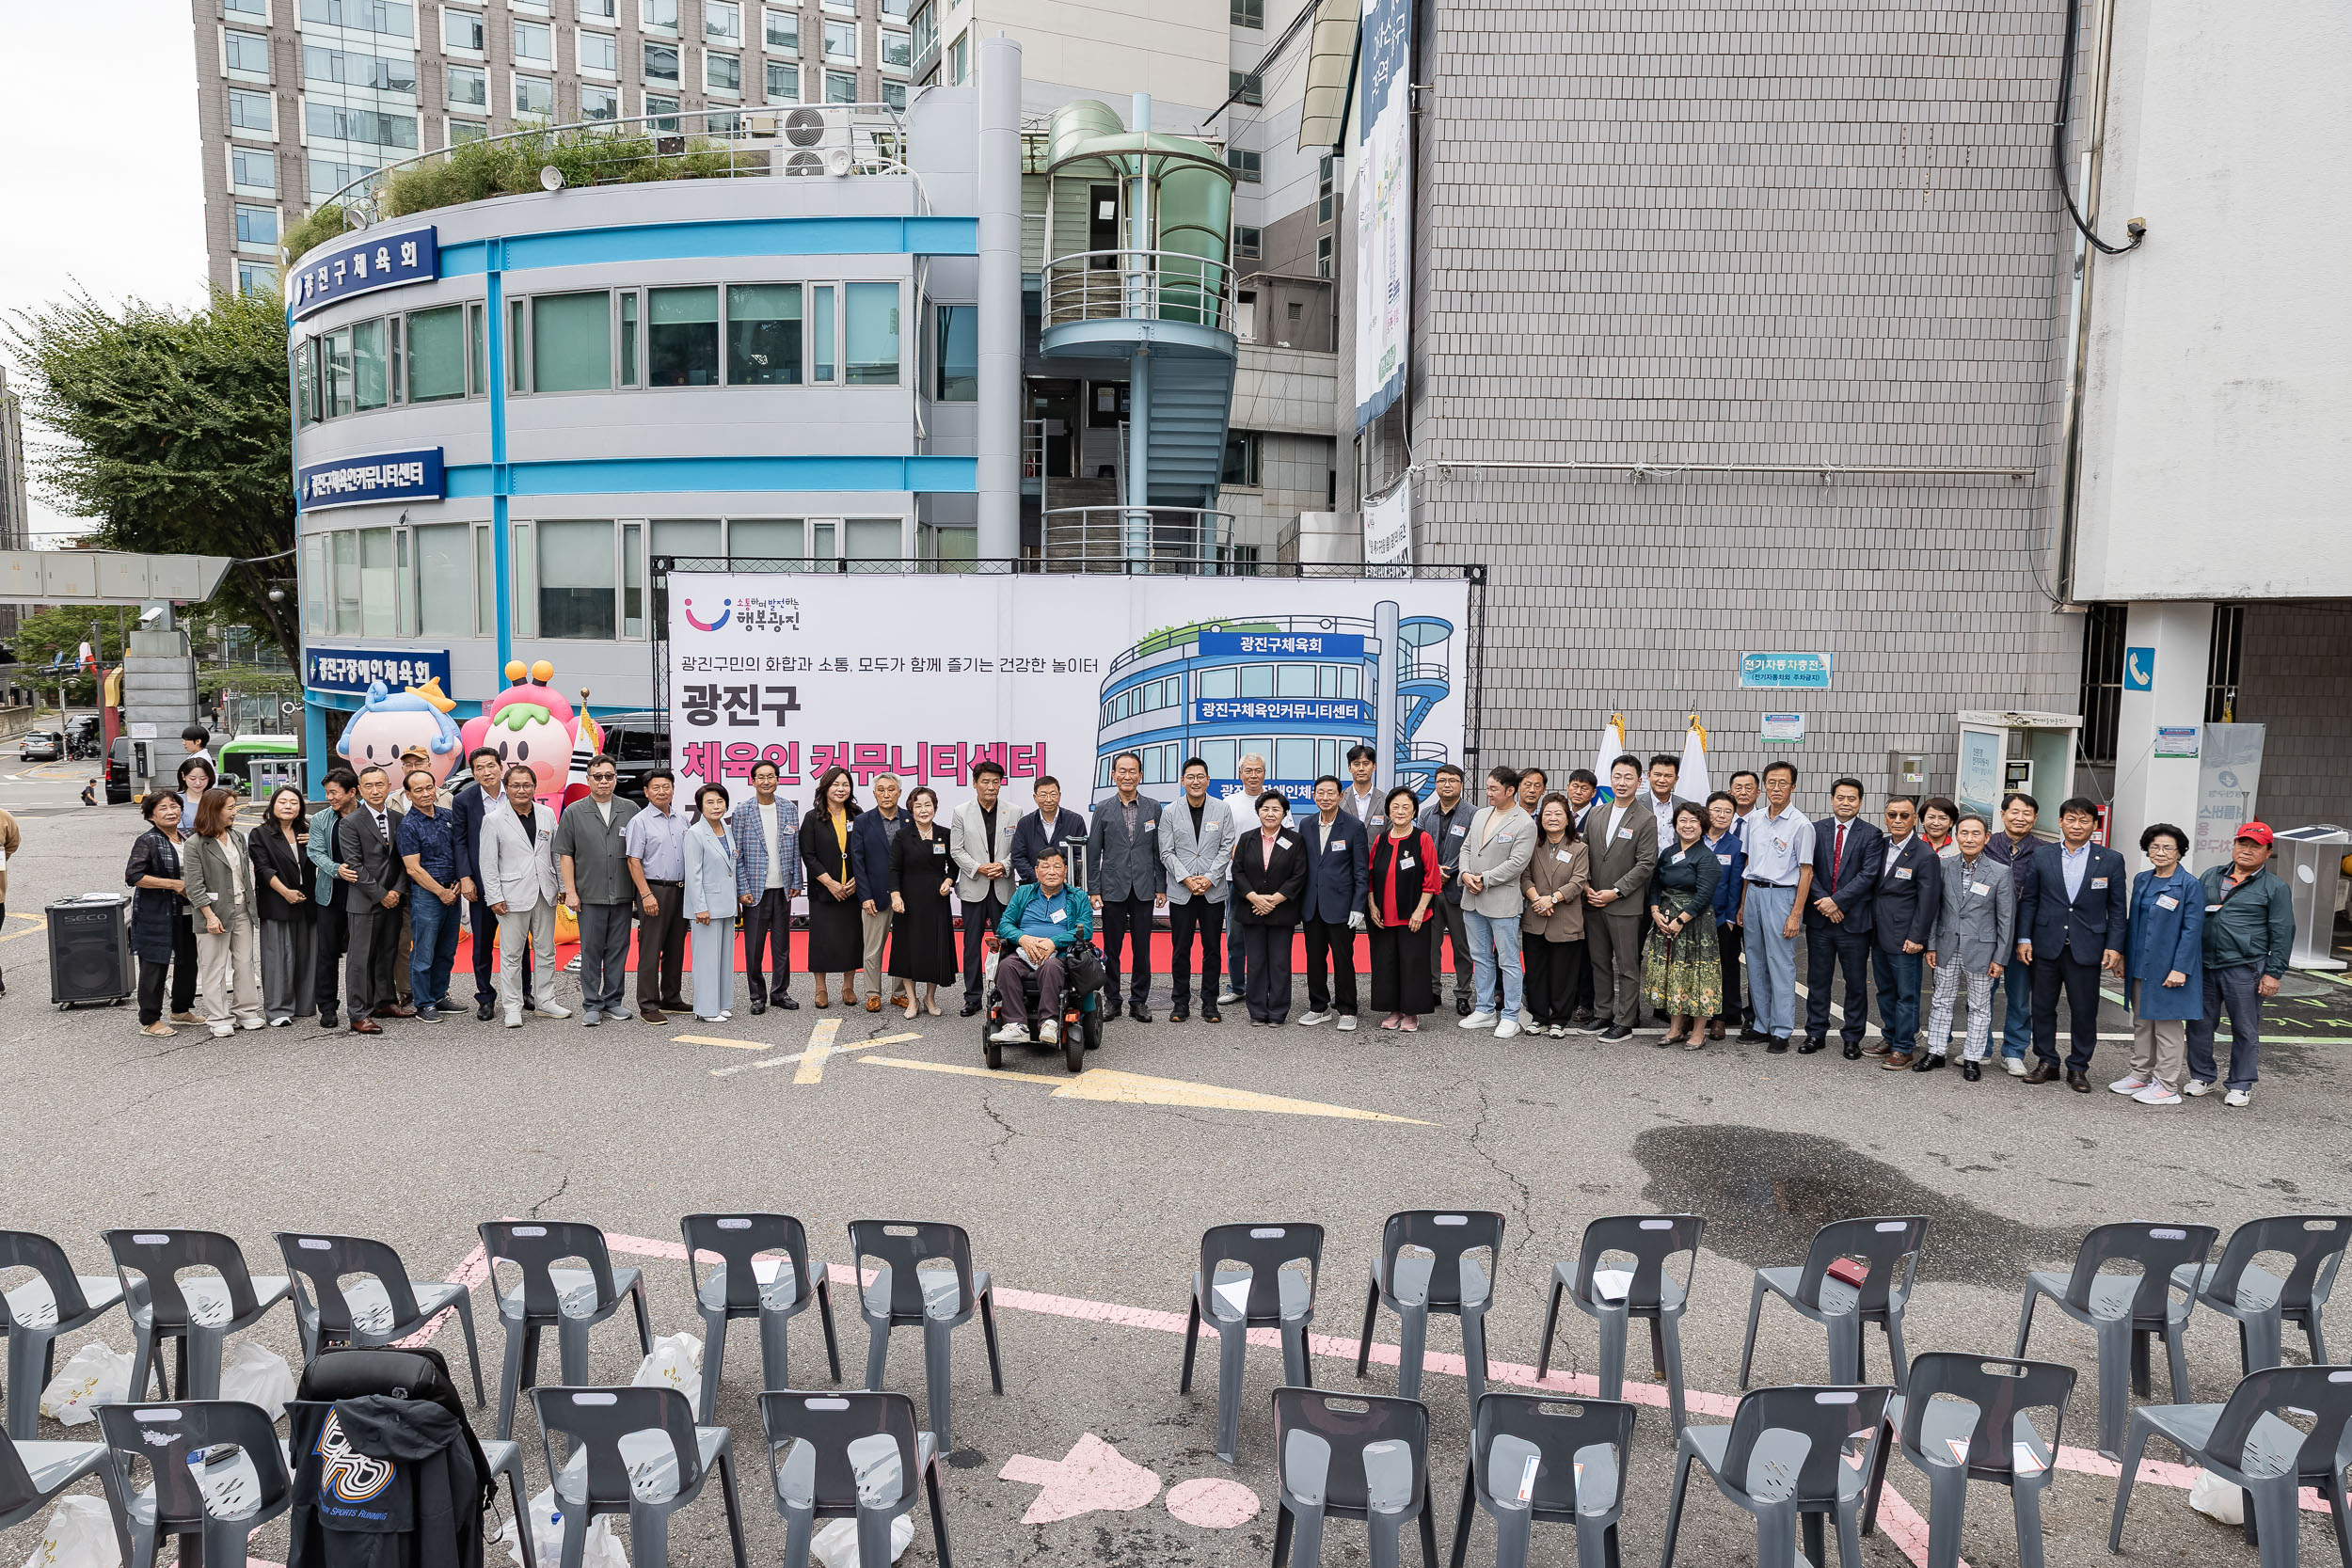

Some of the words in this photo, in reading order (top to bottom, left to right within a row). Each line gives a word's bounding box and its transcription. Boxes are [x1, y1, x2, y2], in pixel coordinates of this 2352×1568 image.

[304, 241, 418, 298] 광진구체육회
[311, 462, 424, 497] 광진구체육인커뮤니티센터
[737, 597, 767, 611] 소통하며
[768, 597, 800, 611] 발전하는
[737, 610, 800, 633] 행복광진
[1240, 636, 1323, 654] 광진구체육회
[319, 657, 431, 686] 광진구장애인체육회
[681, 656, 760, 673] 광진구민의
[765, 656, 813, 673] 화합과
[818, 657, 853, 673] 소통,
[858, 657, 906, 673] 모두가
[911, 656, 942, 673] 함께
[946, 657, 994, 673] 즐기는
[999, 657, 1047, 673] 건강한
[1052, 657, 1099, 673] 놀이터
[681, 684, 802, 727] 광진구
[1201, 702, 1359, 720] 광진구체육인커뮤니티센터
[682, 741, 802, 786] 체육인
[64, 913, 107, 922] SECO
